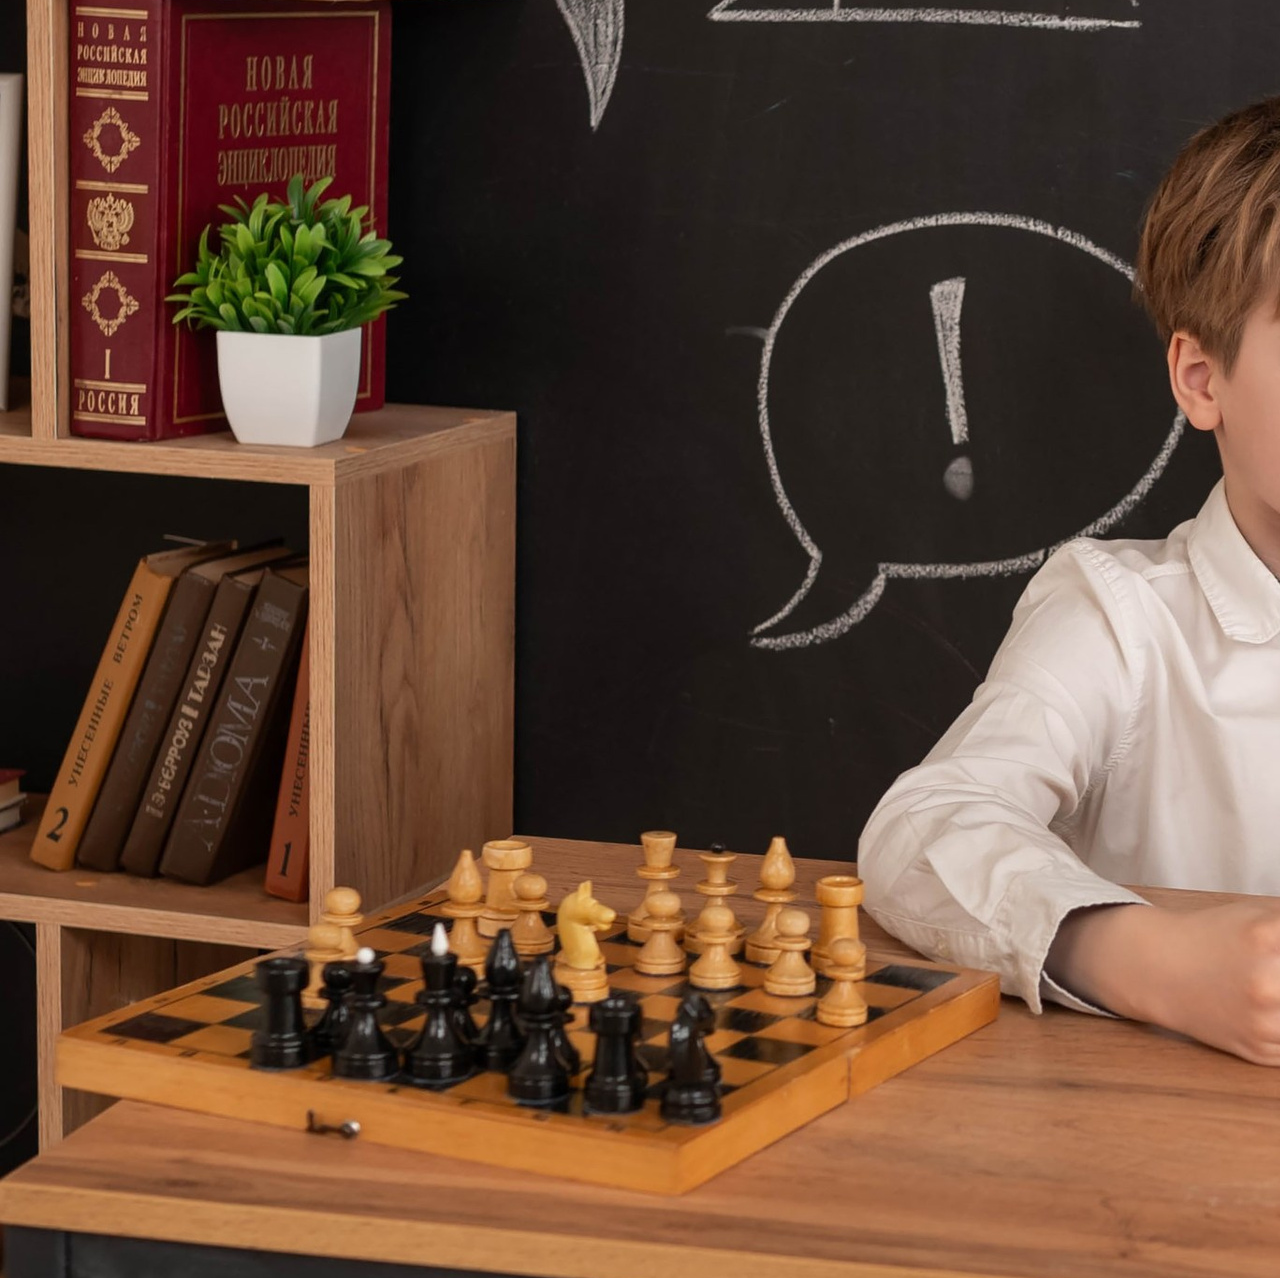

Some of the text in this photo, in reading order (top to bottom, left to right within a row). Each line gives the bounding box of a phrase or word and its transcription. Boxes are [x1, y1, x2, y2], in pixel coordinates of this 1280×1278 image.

[77, 44, 147, 65] РОССИЙСКАЯ
[77, 67, 147, 88] ЭНЦИКЛОПЕДИЯ
[246, 55, 314, 92] НОВАЯ
[218, 99, 339, 139] РОССИЙСКАЯ
[217, 144, 338, 188] ЭНЦИКЛОПЕДИЯ
[78, 388, 140, 417] РОССИЯ
[68, 594, 143, 787] УНЕСЕННЫЕ ВЕТРОМ
[46, 807, 69, 843] 2
